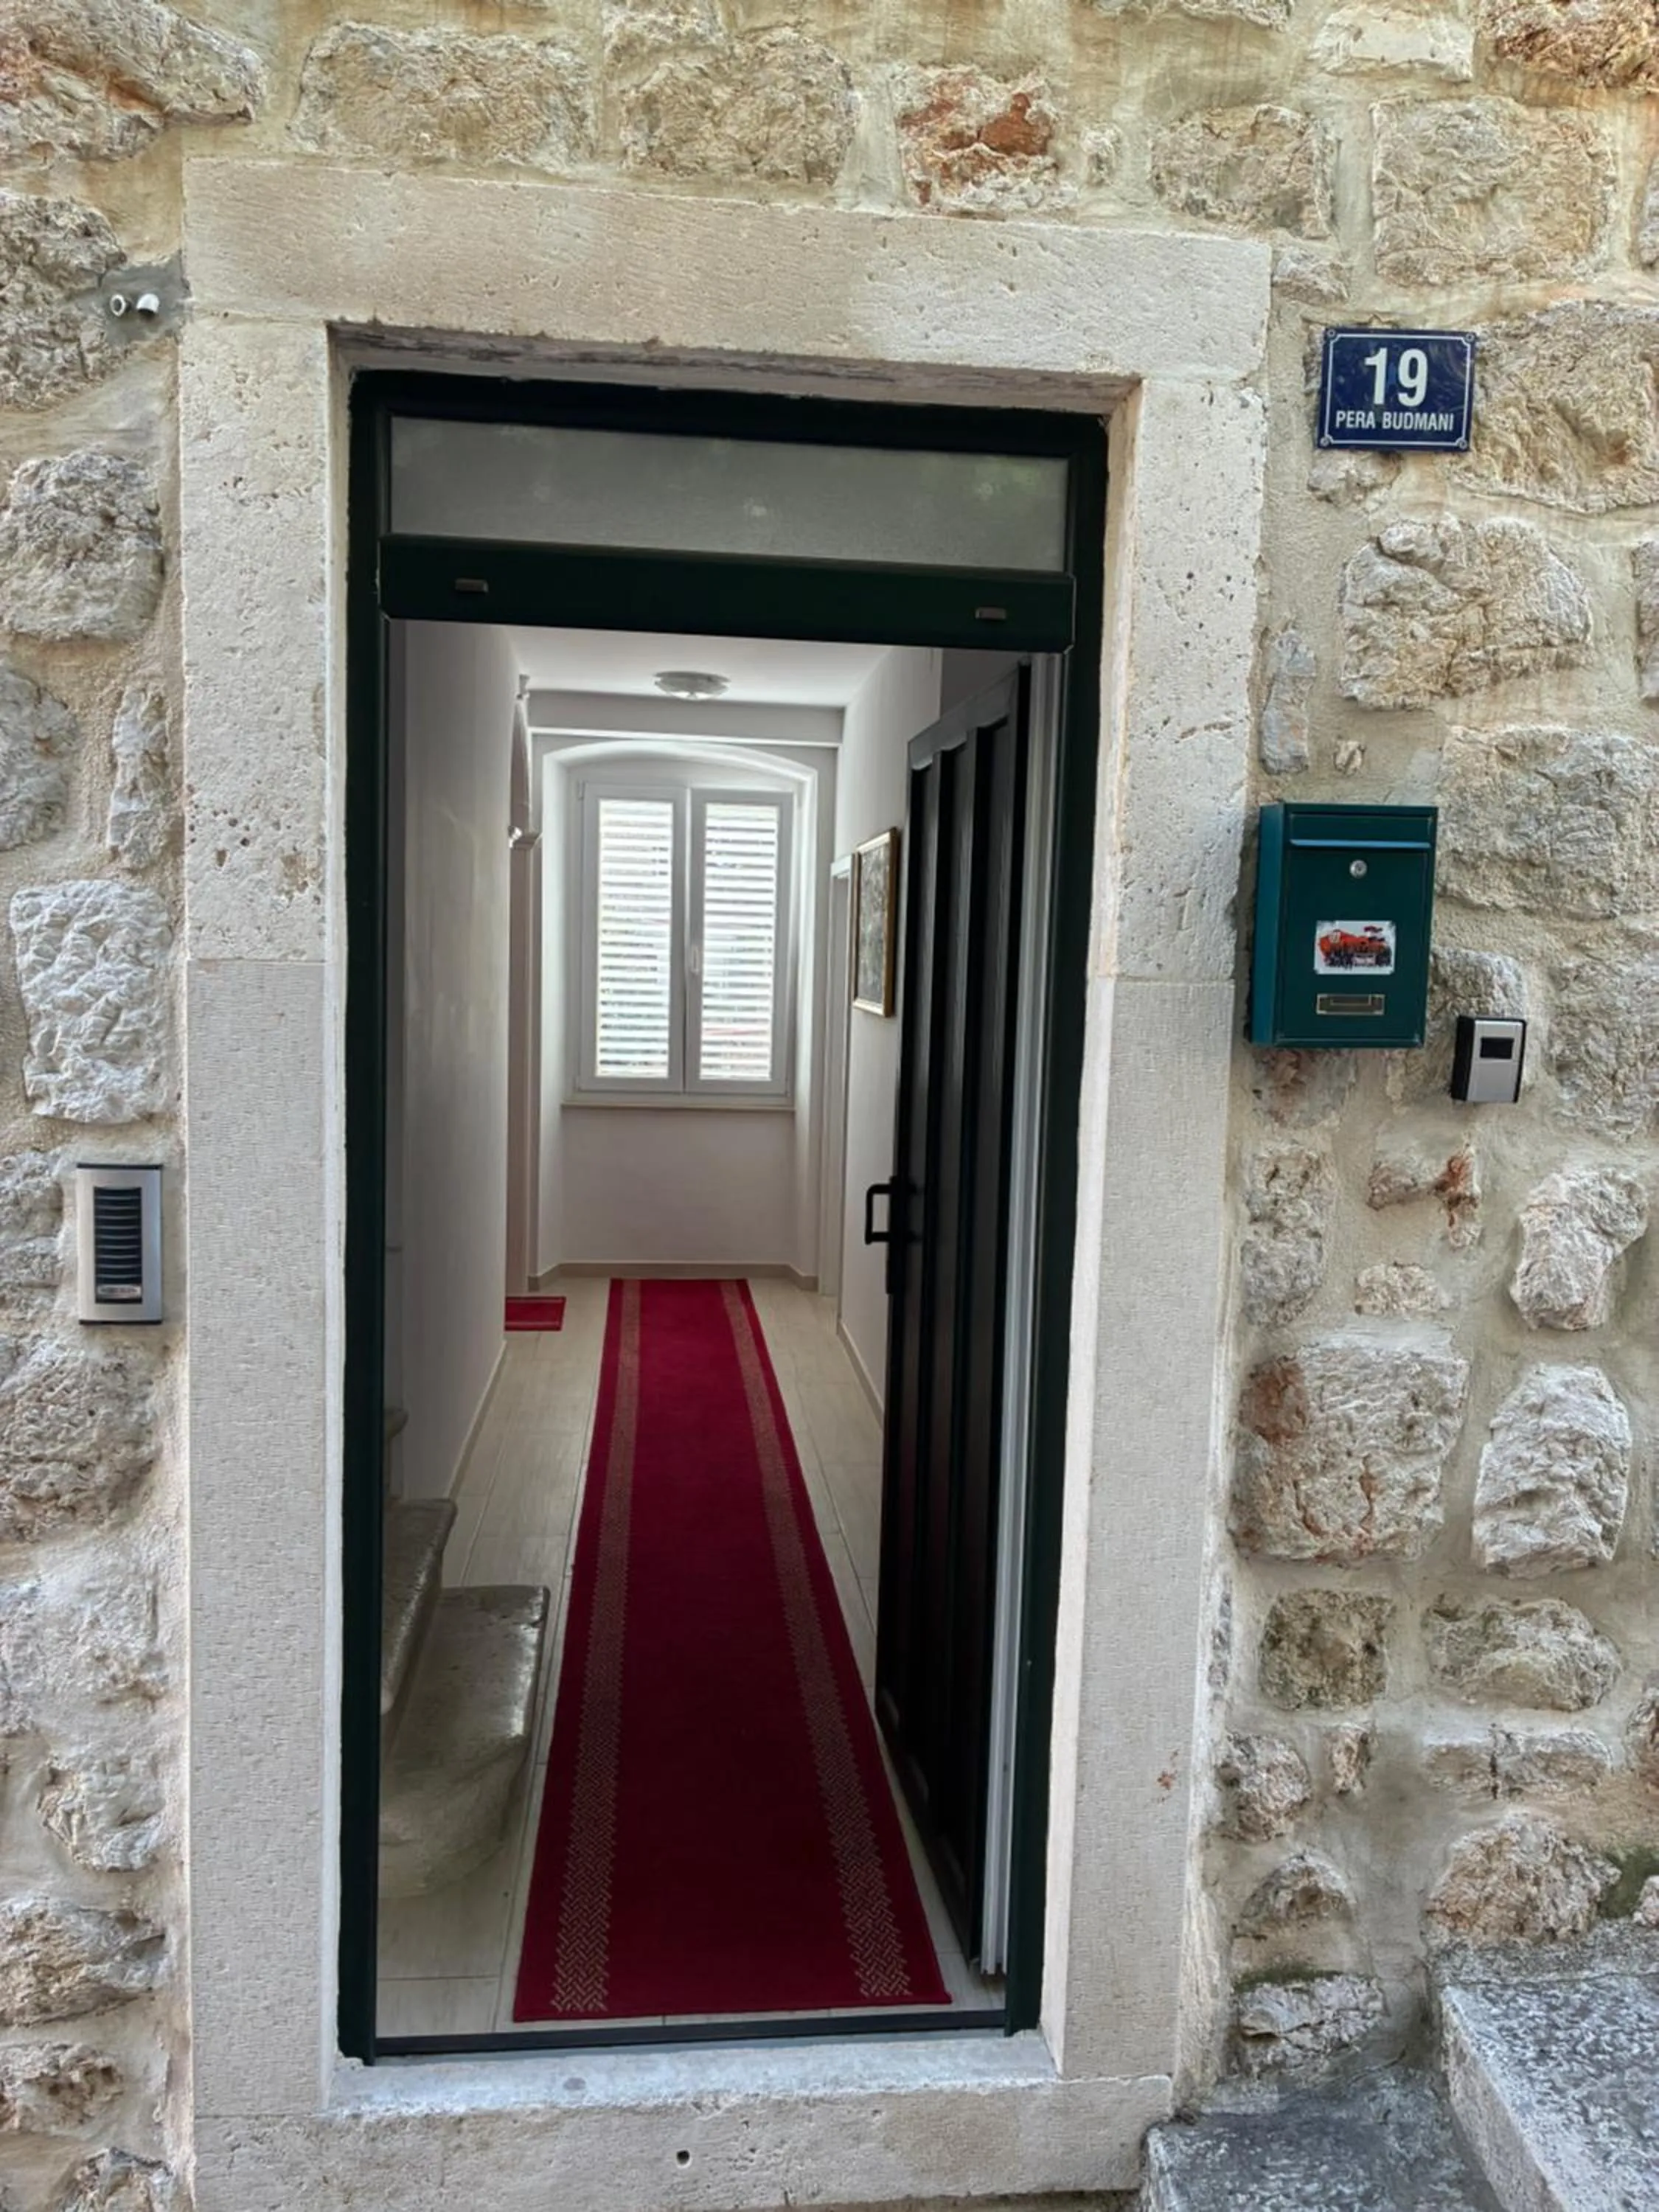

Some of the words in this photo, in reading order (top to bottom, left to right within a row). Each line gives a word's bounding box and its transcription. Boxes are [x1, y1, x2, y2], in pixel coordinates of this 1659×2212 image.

[1365, 347, 1428, 407] 19
[1335, 411, 1375, 429] PERA
[1382, 411, 1454, 431] BUDMANI
